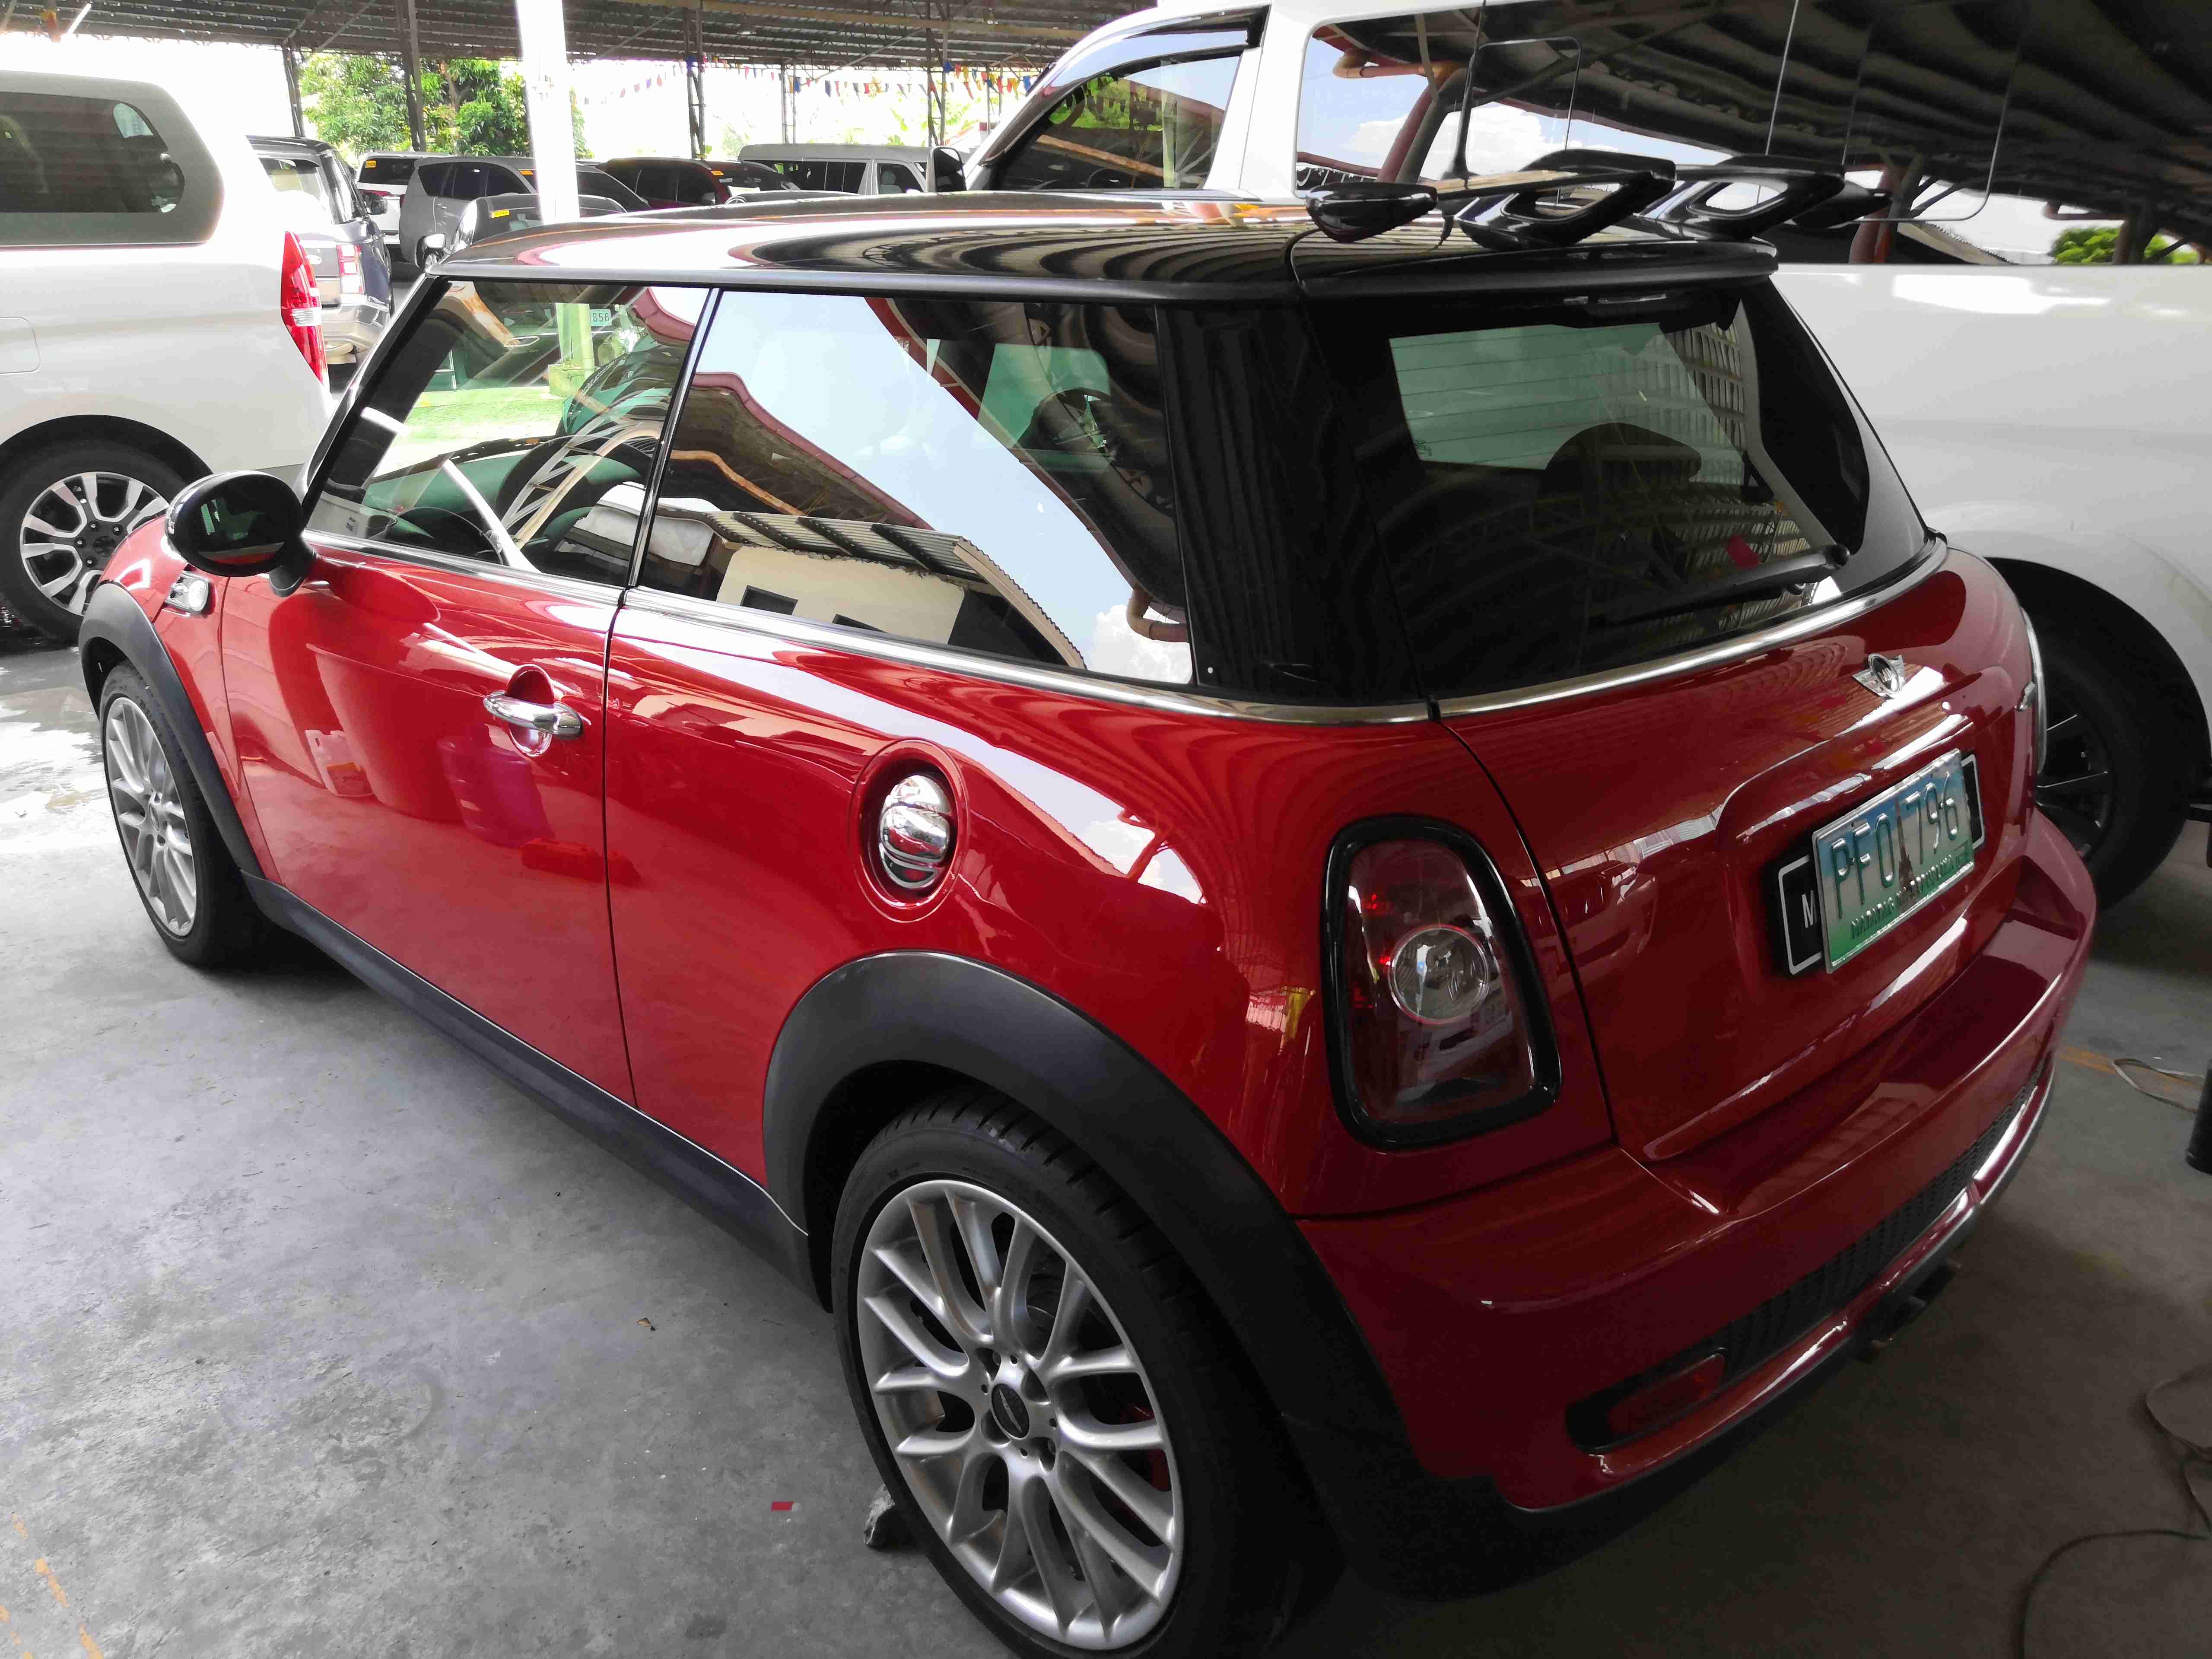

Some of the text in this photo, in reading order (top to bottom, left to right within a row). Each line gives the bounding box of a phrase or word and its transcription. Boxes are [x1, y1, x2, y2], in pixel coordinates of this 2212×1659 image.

[592, 312, 609, 322] 858
[1831, 771, 1959, 919] PFO 796
